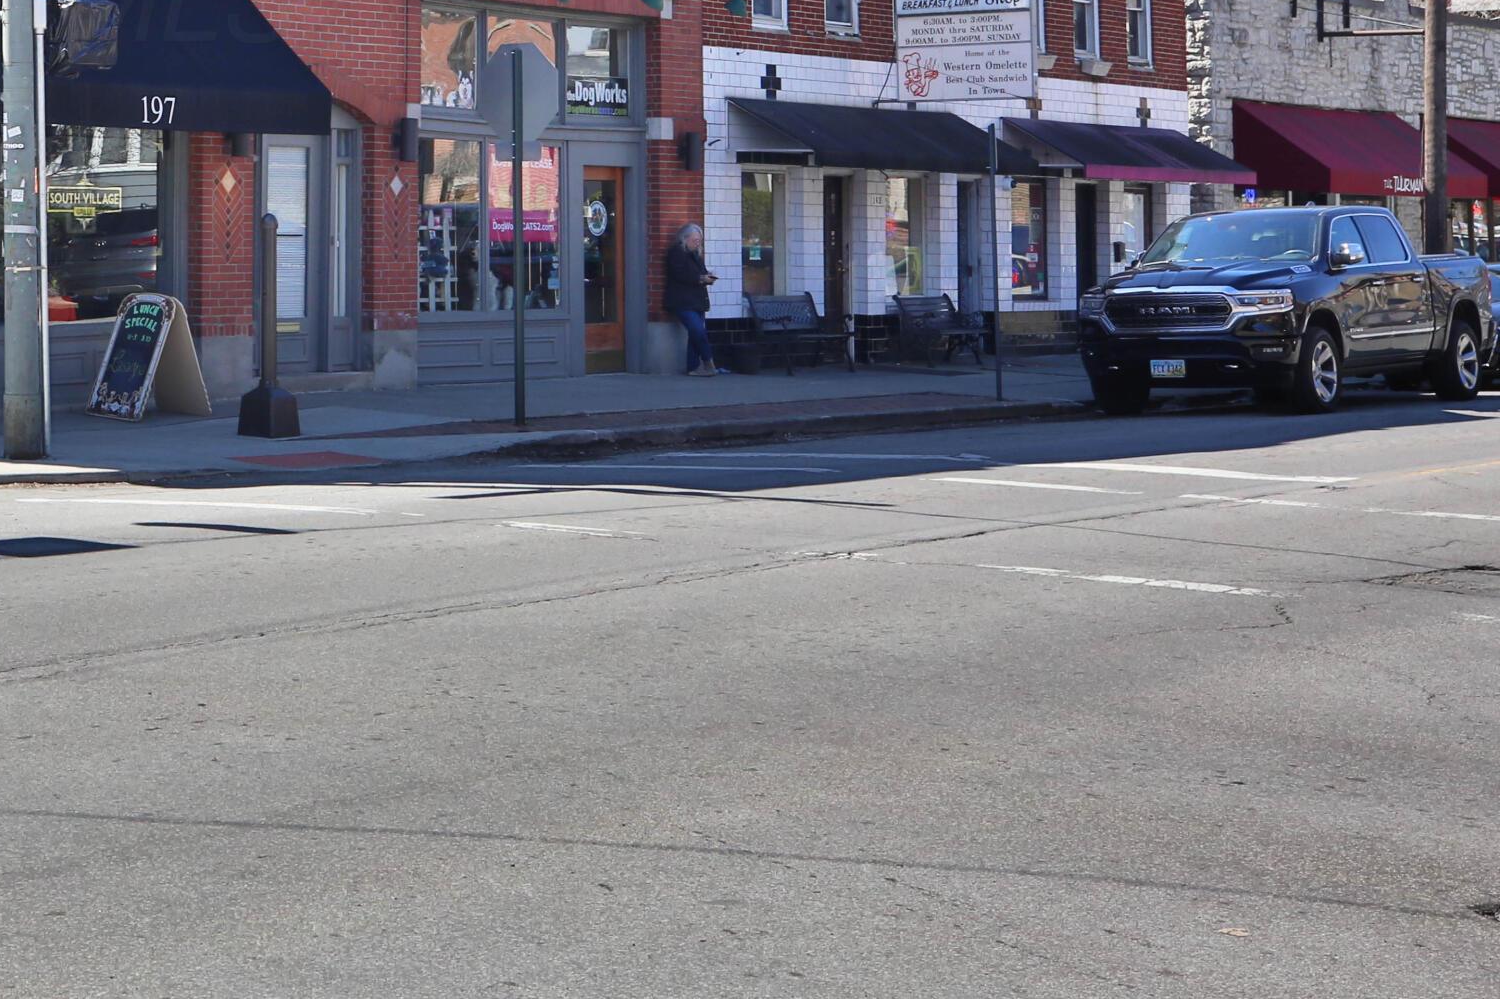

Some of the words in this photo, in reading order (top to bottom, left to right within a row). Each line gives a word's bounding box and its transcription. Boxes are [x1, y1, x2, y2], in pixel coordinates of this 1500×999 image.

[902, 0, 946, 10] BREAKFAST
[912, 27, 946, 35] MONDAY
[970, 24, 1014, 32] SATURDAY
[943, 62, 980, 71] Western
[986, 61, 1027, 69] Omelette
[946, 76, 962, 84] Best
[989, 74, 1028, 82] Sandwich
[575, 81, 626, 106] DogWorks
[982, 86, 1005, 95] Town
[141, 95, 176, 124] 197
[50, 193, 80, 204] SOUTH
[83, 193, 119, 204] VILLAGE
[133, 305, 160, 316] LUNCH
[125, 318, 158, 332] SPECIAL
